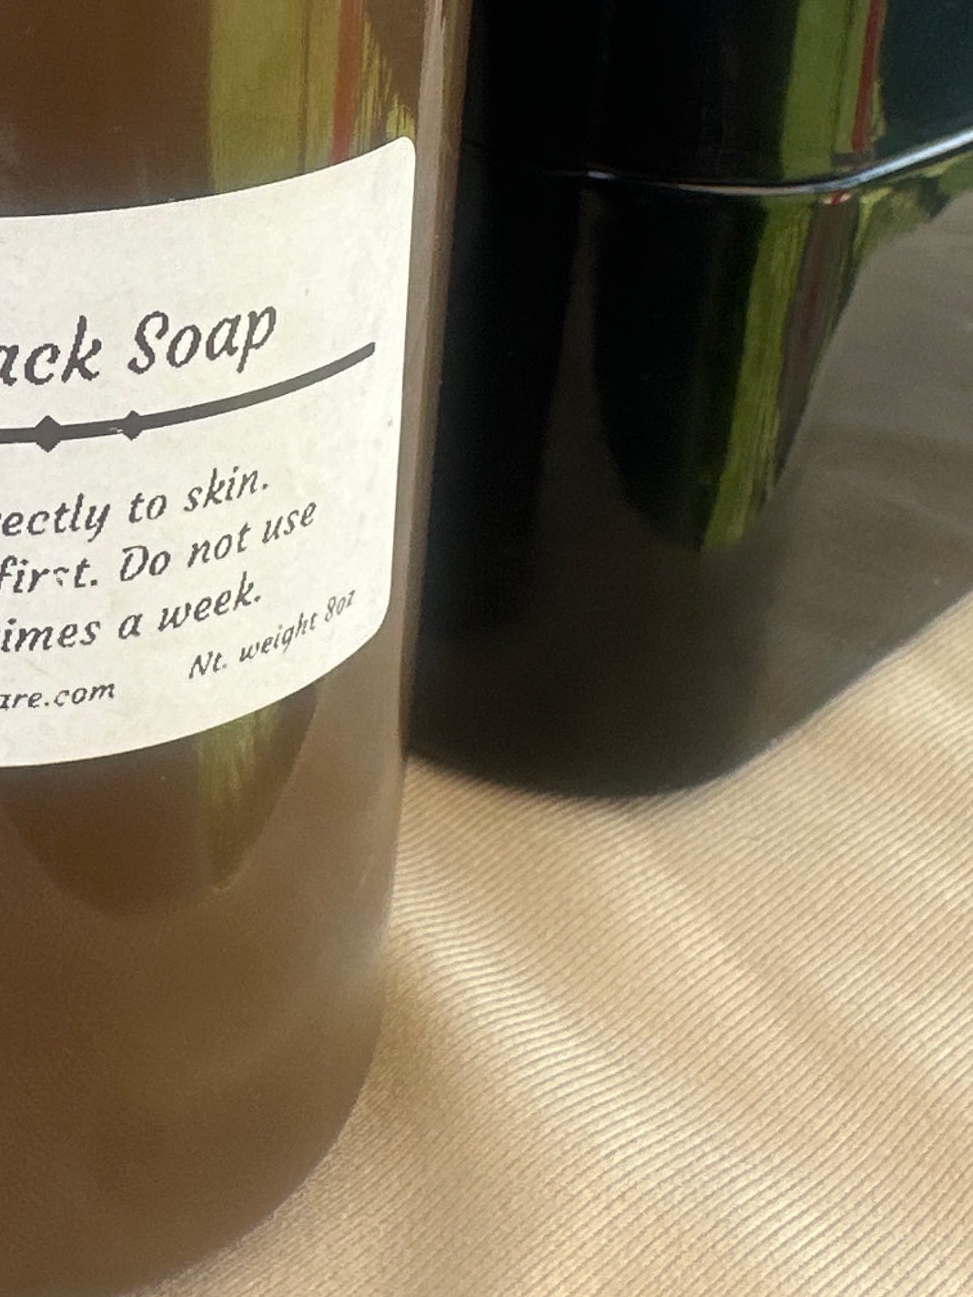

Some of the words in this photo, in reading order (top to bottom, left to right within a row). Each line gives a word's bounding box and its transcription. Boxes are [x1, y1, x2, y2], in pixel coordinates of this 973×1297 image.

[126, 305, 277, 376] Soap
[127, 492, 168, 525] to
[182, 465, 270, 513] skin.
[119, 544, 172, 583] Do
[186, 521, 253, 569] not
[261, 501, 318, 545] use
[117, 612, 144, 641] a
[156, 570, 262, 633] week.
[188, 650, 228, 680] Nt.
[238, 611, 320, 663] weight
[323, 589, 356, 623] 8oz
